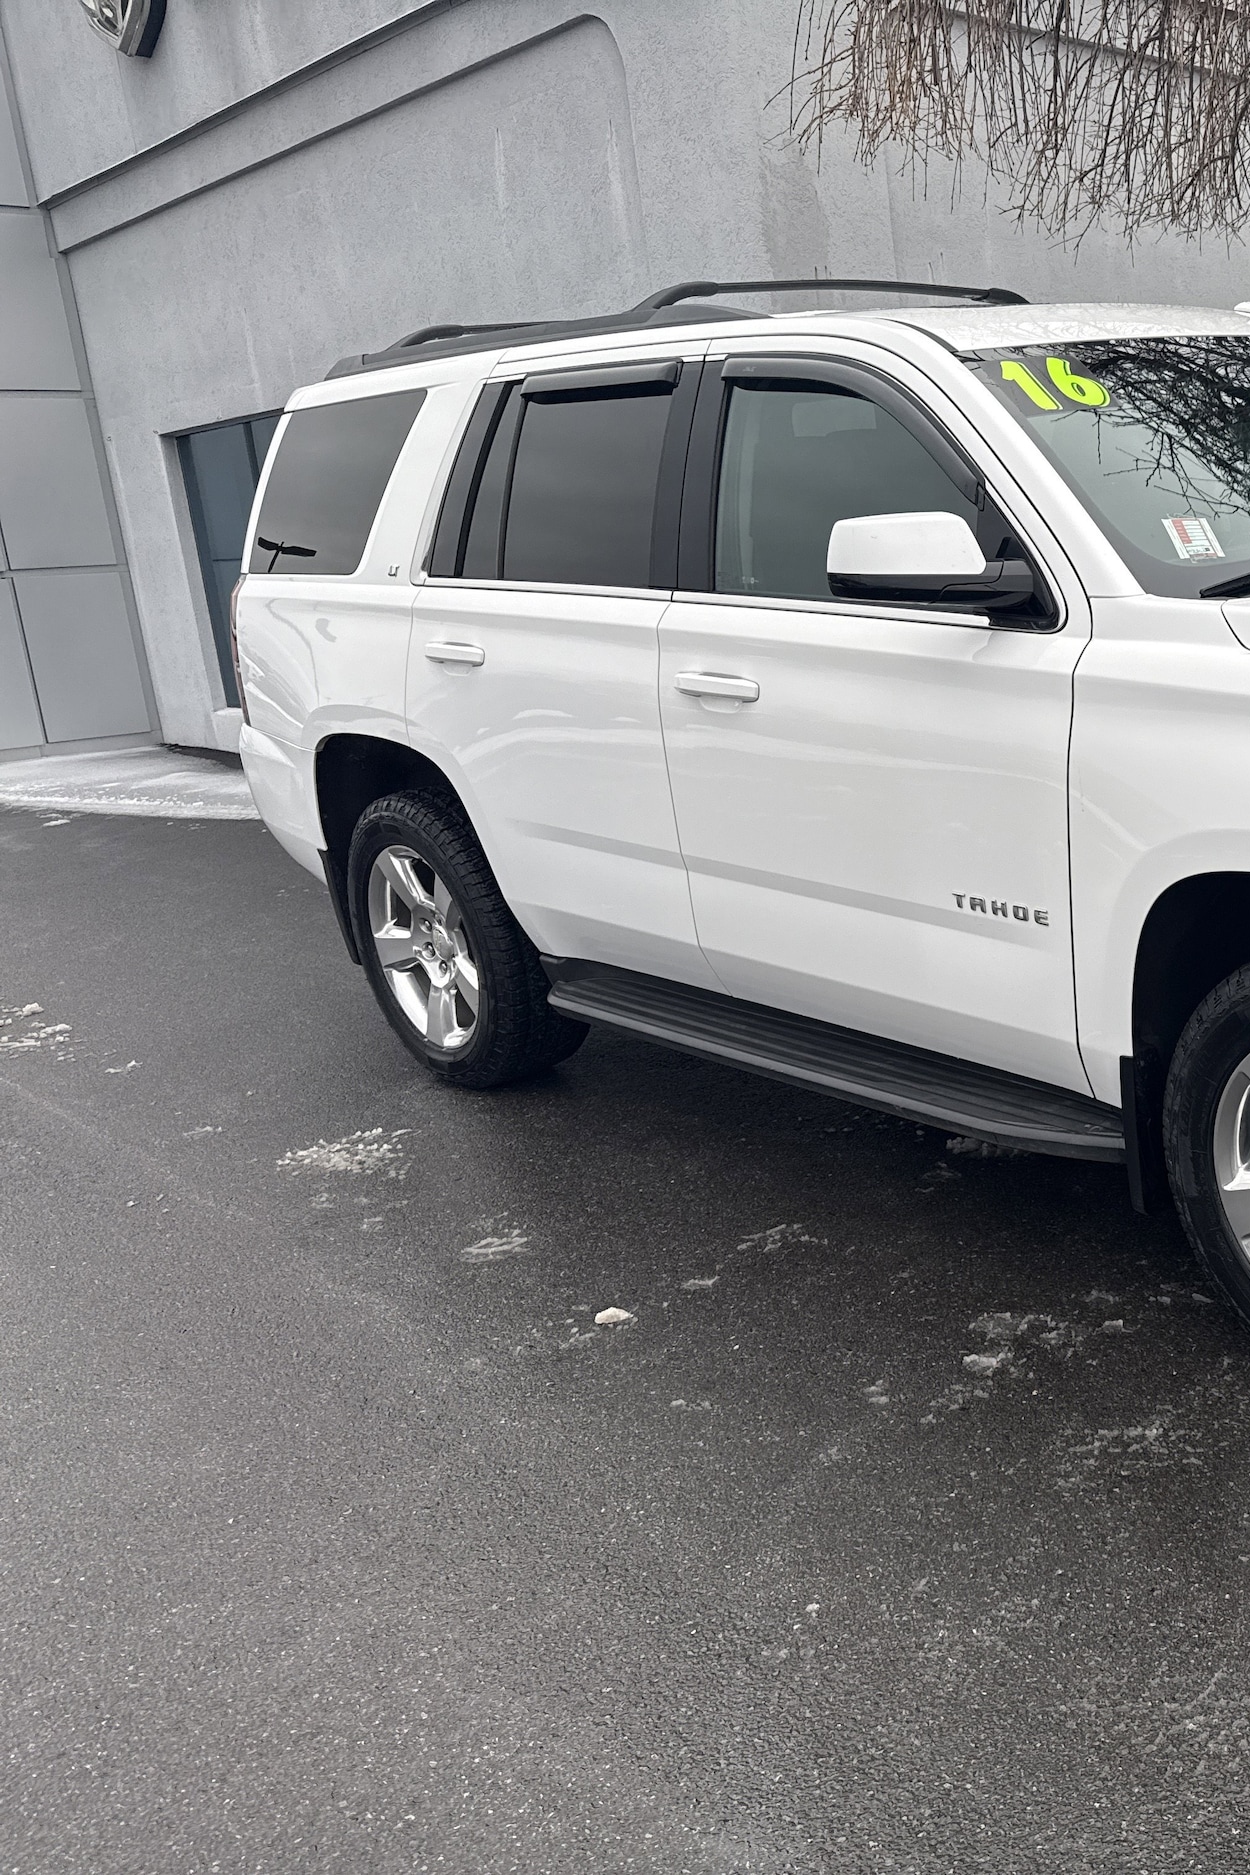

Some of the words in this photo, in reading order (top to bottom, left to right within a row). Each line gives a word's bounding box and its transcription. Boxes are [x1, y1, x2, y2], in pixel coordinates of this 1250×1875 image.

[1000, 356, 1110, 411] 16
[388, 564, 400, 577] LT
[952, 891, 1049, 927] TAHOE
